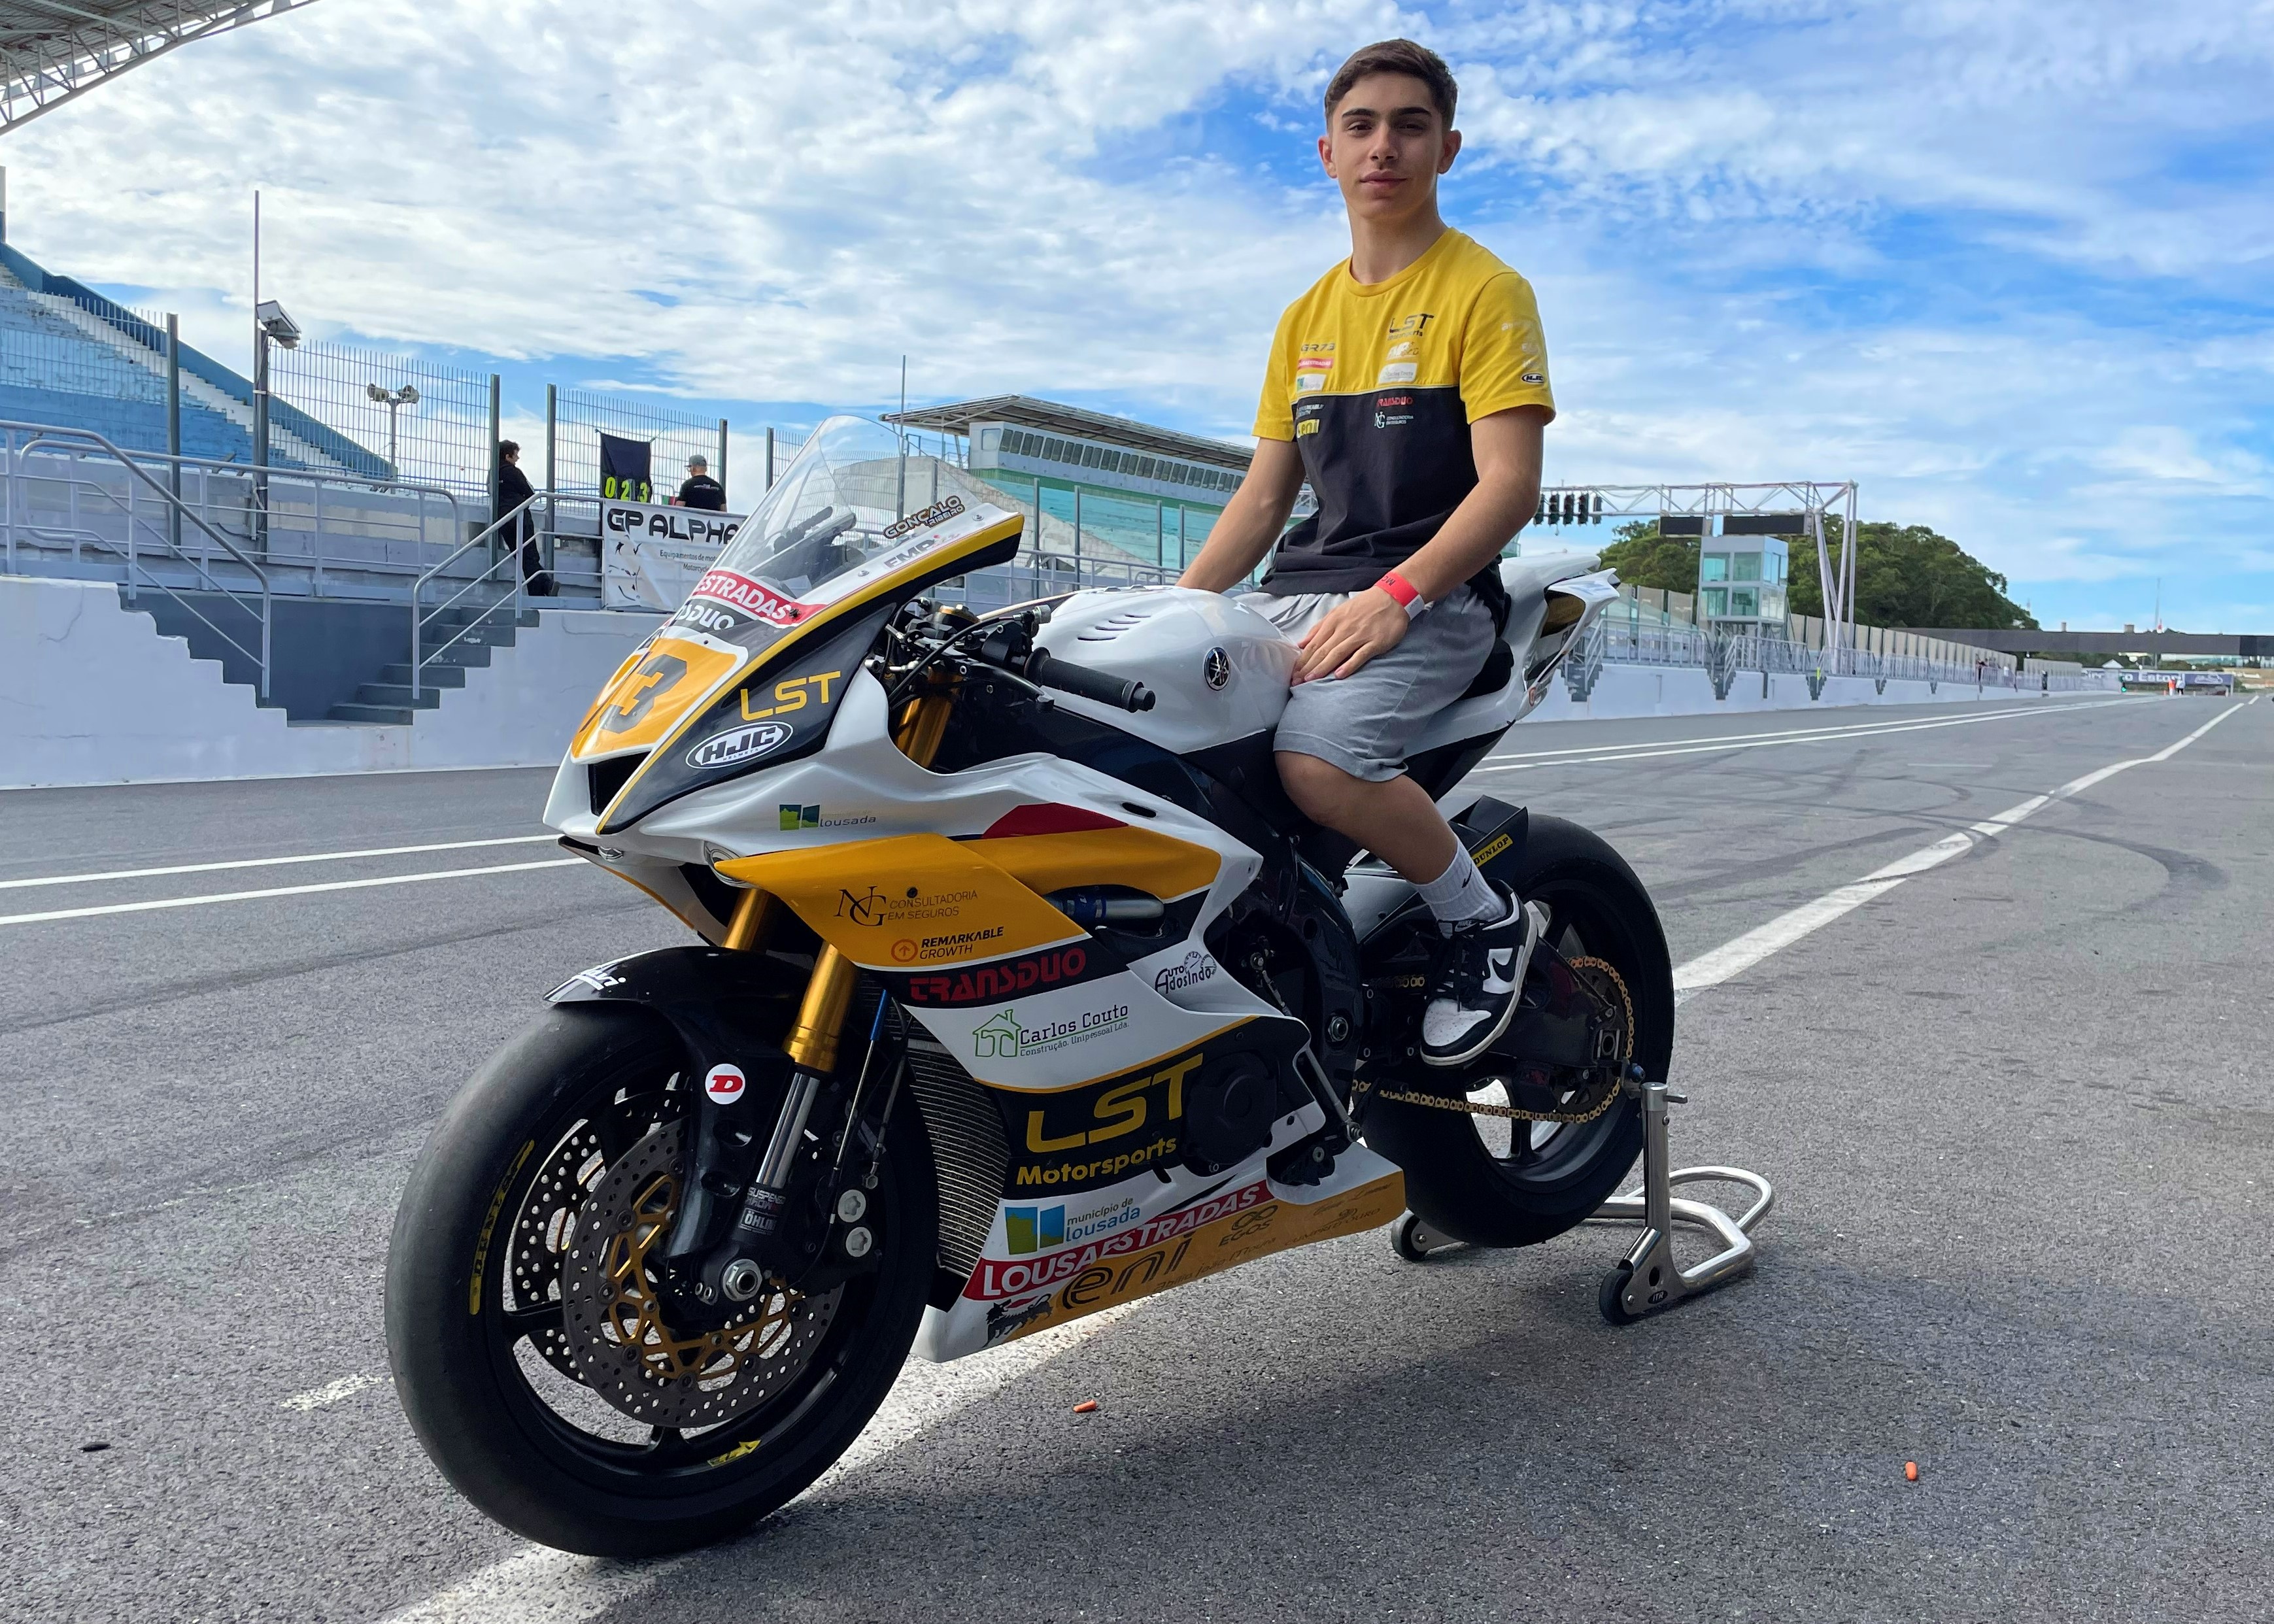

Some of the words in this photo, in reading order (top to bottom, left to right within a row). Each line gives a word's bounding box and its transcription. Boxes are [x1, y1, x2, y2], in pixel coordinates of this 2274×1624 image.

[1389, 313, 1434, 333] LST
[1301, 343, 1335, 352] GR73
[607, 508, 643, 534] GP
[928, 505, 965, 527] RIBEIRO
[740, 671, 841, 721] LST
[702, 727, 776, 764] HJC
[820, 815, 876, 828] lousada
[1473, 837, 1509, 865] DUNLOP
[887, 911, 904, 921] EM
[907, 906, 959, 919] SEGUROS
[889, 890, 978, 909] CONSULTADORIA
[921, 926, 1004, 948] REMARKABLE
[919, 944, 974, 960] GROWTH
[909, 948, 1087, 1002] TRANSDUO
[1020, 1021, 1077, 1045] Carlos
[1082, 1004, 1129, 1028] Couto
[1071, 1027, 1113, 1045] Unipessoal
[1027, 1053, 1203, 1153] LST
[1017, 1138, 1176, 1185] Motorsports
[745, 1210, 777, 1230] ÖHLIN
[1066, 1206, 1140, 1242] lousada
[1067, 1203, 1119, 1226] município
[1121, 1198, 1133, 1208] de
[983, 1185, 1261, 1296] LOUSAESTRADAS
[1218, 1219, 1274, 1247] EGOS
[1062, 1230, 1196, 1309] eni
